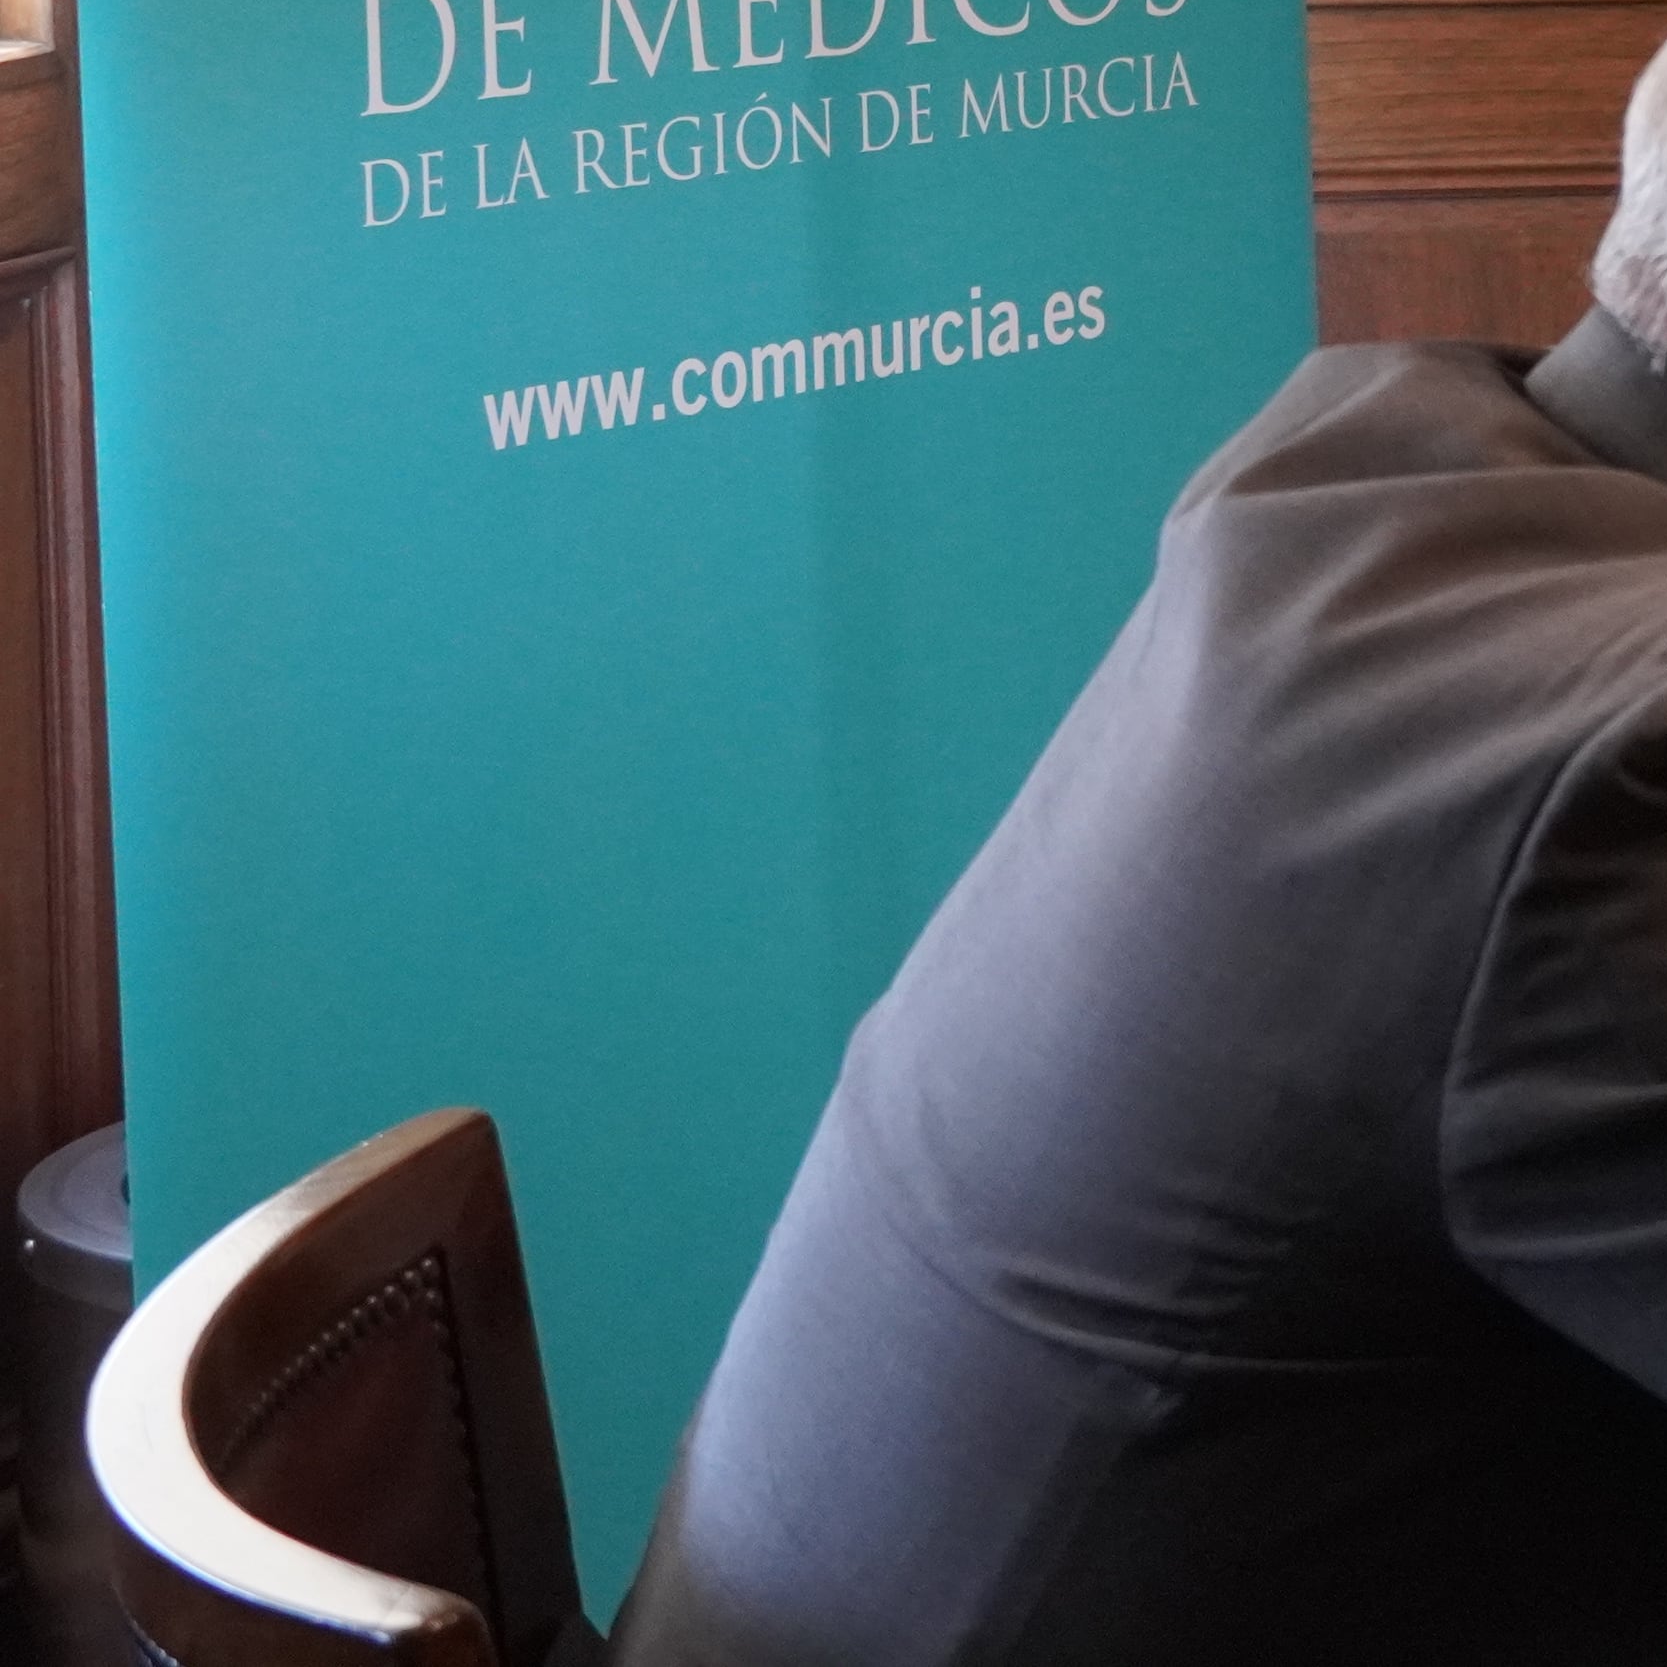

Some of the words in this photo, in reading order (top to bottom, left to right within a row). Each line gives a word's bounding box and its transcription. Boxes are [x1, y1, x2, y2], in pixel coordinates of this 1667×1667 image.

[360, 150, 446, 227] DE
[473, 137, 550, 209] LA
[572, 90, 832, 194] REGIÓN
[858, 83, 933, 152] DE
[959, 51, 1199, 138] MURCIA
[483, 285, 1106, 451] www.commurcia.es
